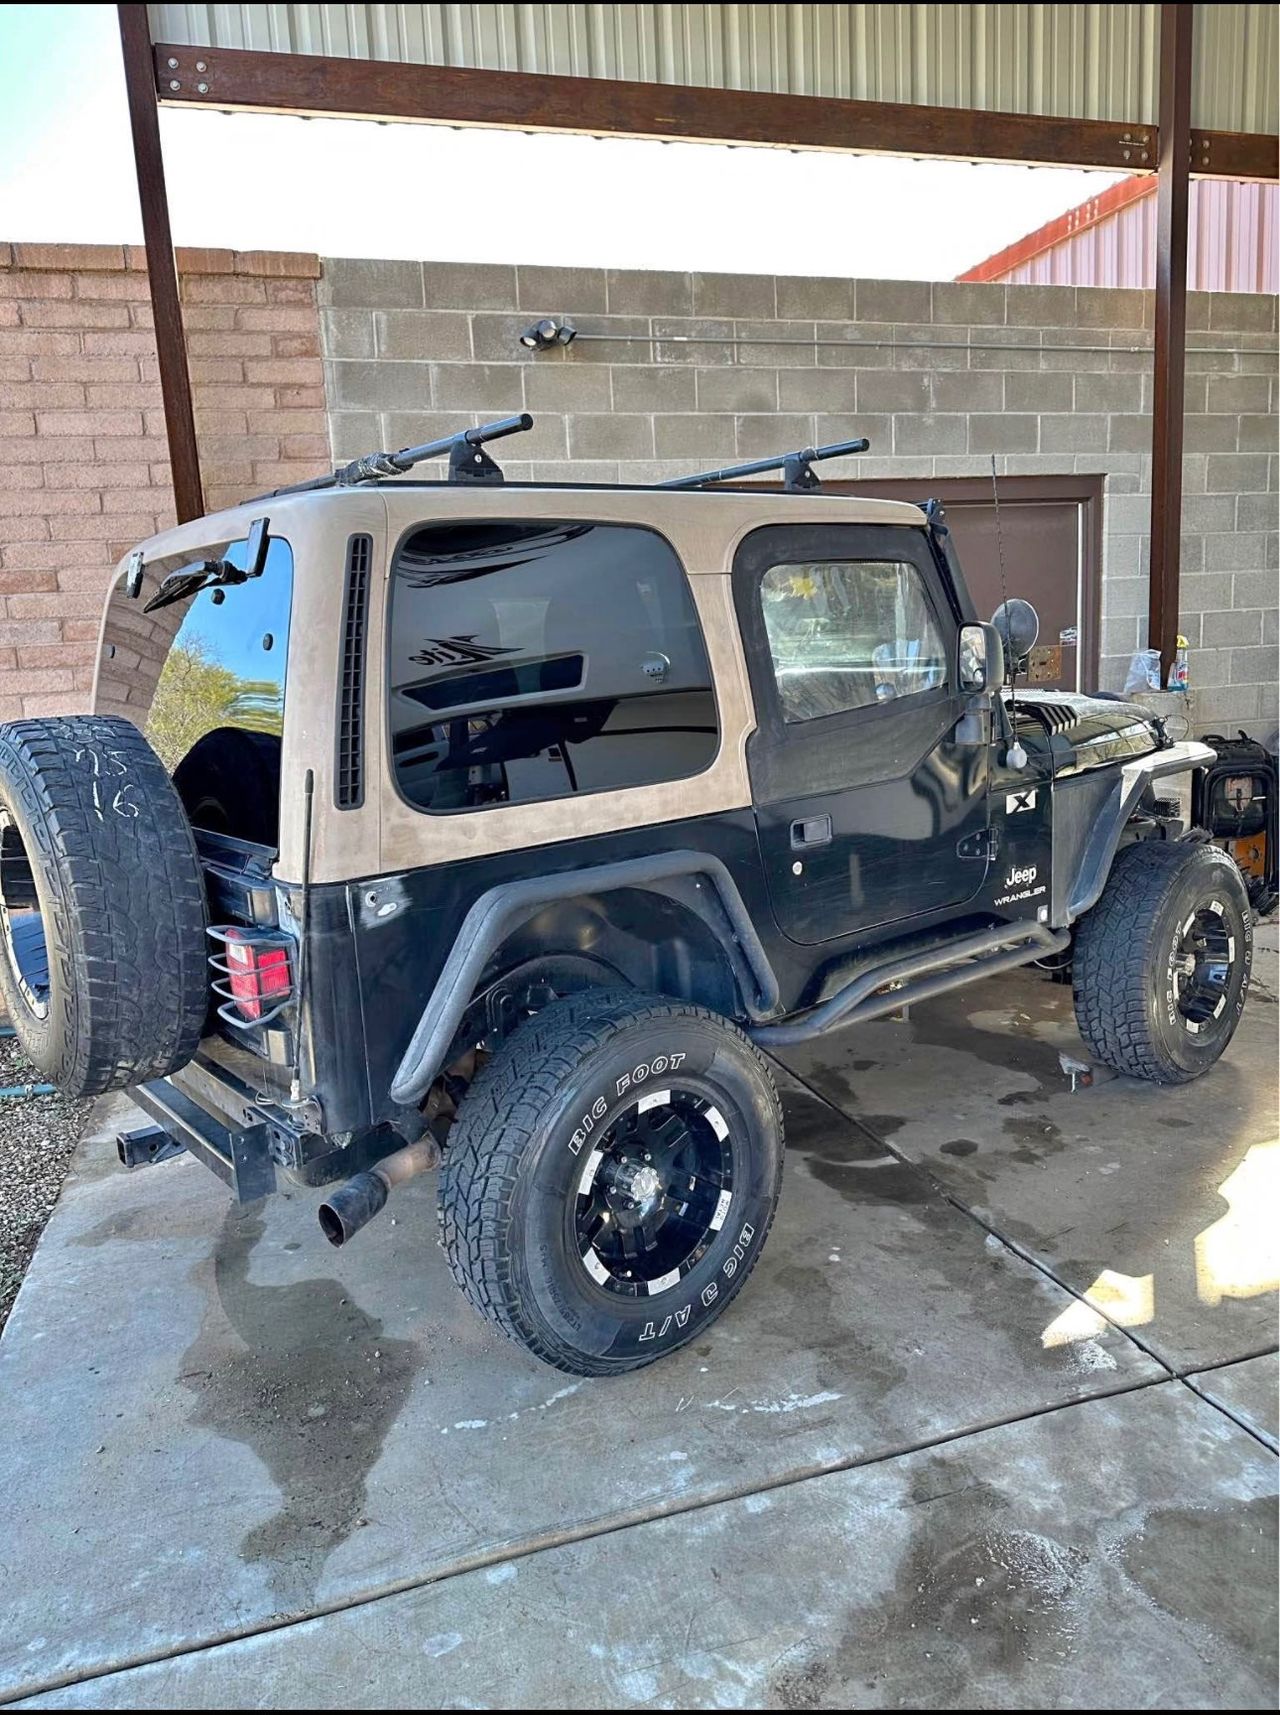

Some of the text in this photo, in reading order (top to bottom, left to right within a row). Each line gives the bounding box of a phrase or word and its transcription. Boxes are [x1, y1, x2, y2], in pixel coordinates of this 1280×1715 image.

[93, 781, 139, 822] 16
[1006, 789, 1037, 814] X
[1005, 867, 1037, 887] Jeep
[994, 885, 1047, 907] WRANGLER
[568, 1053, 686, 1156] BIG FOOT
[723, 1222, 755, 1278] BIG
[638, 1304, 691, 1341] A/T
